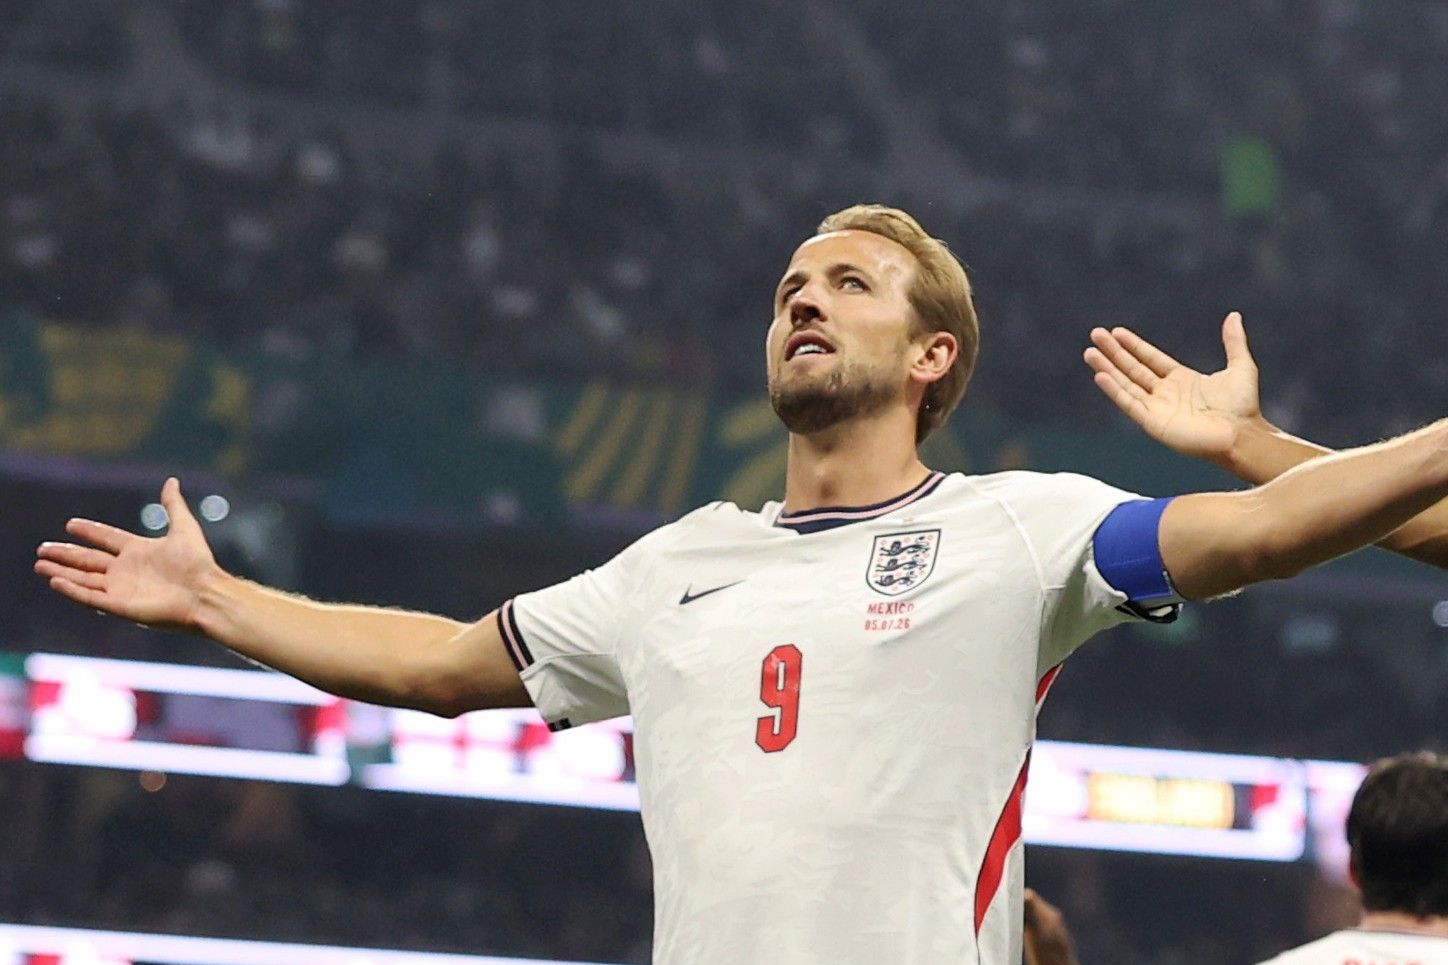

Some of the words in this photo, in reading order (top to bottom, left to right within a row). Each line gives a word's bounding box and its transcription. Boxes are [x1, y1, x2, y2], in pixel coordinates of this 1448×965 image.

[867, 602, 914, 615] MEXICO
[864, 618, 910, 631] 05.07.26
[755, 643, 803, 753] 9
